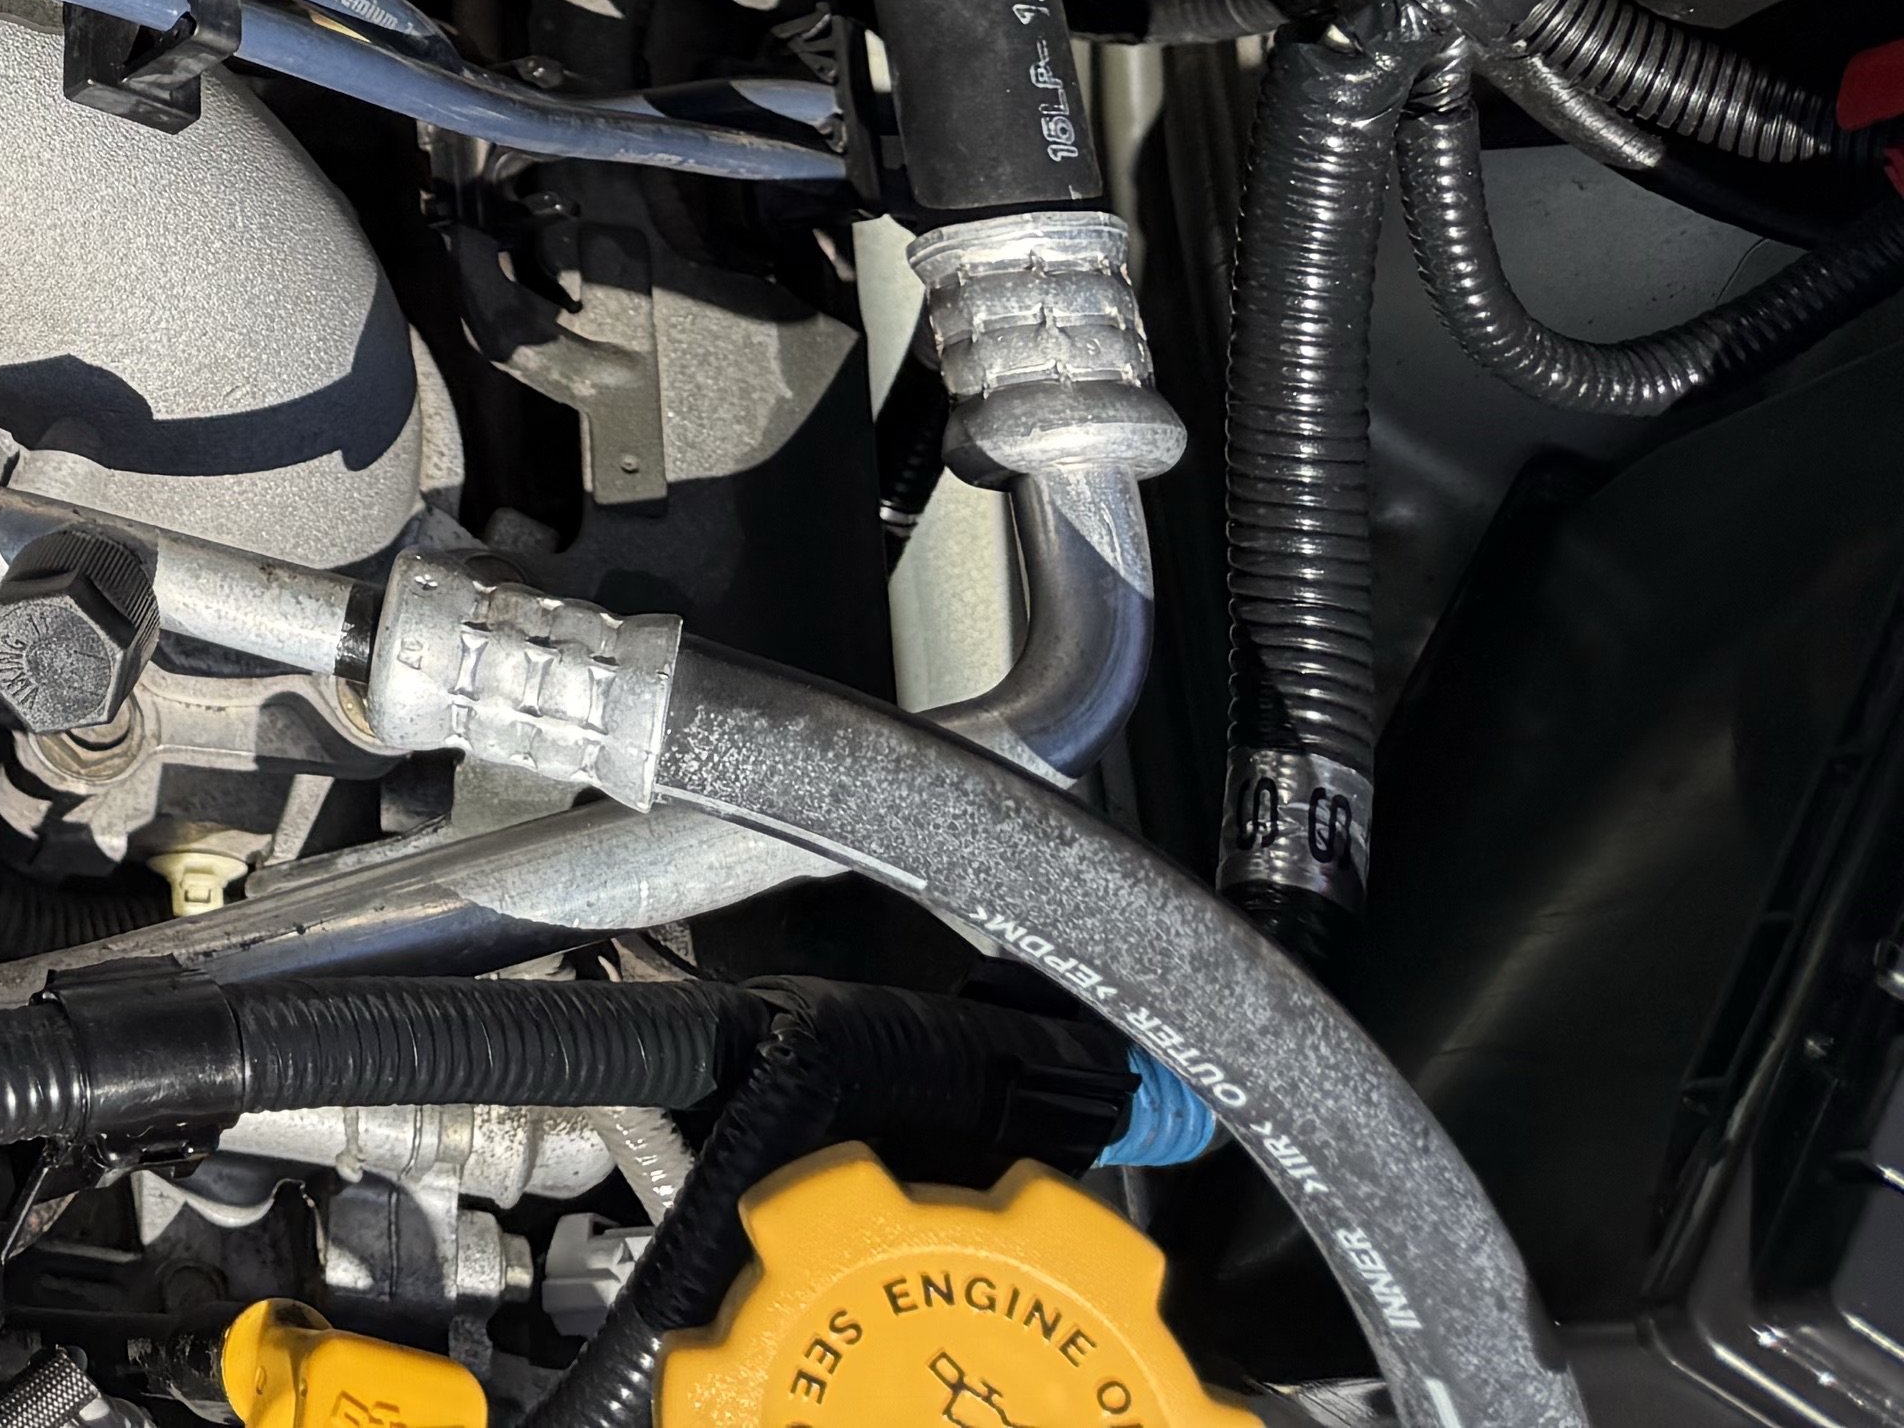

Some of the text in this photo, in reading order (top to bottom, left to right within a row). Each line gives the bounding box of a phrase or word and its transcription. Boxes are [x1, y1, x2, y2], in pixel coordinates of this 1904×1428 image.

[1126, 1003, 1248, 1108] OUTER
[1335, 1226, 1423, 1331] INNER
[790, 1309, 865, 1405] SEE
[882, 1271, 1098, 1369] ENGINE
